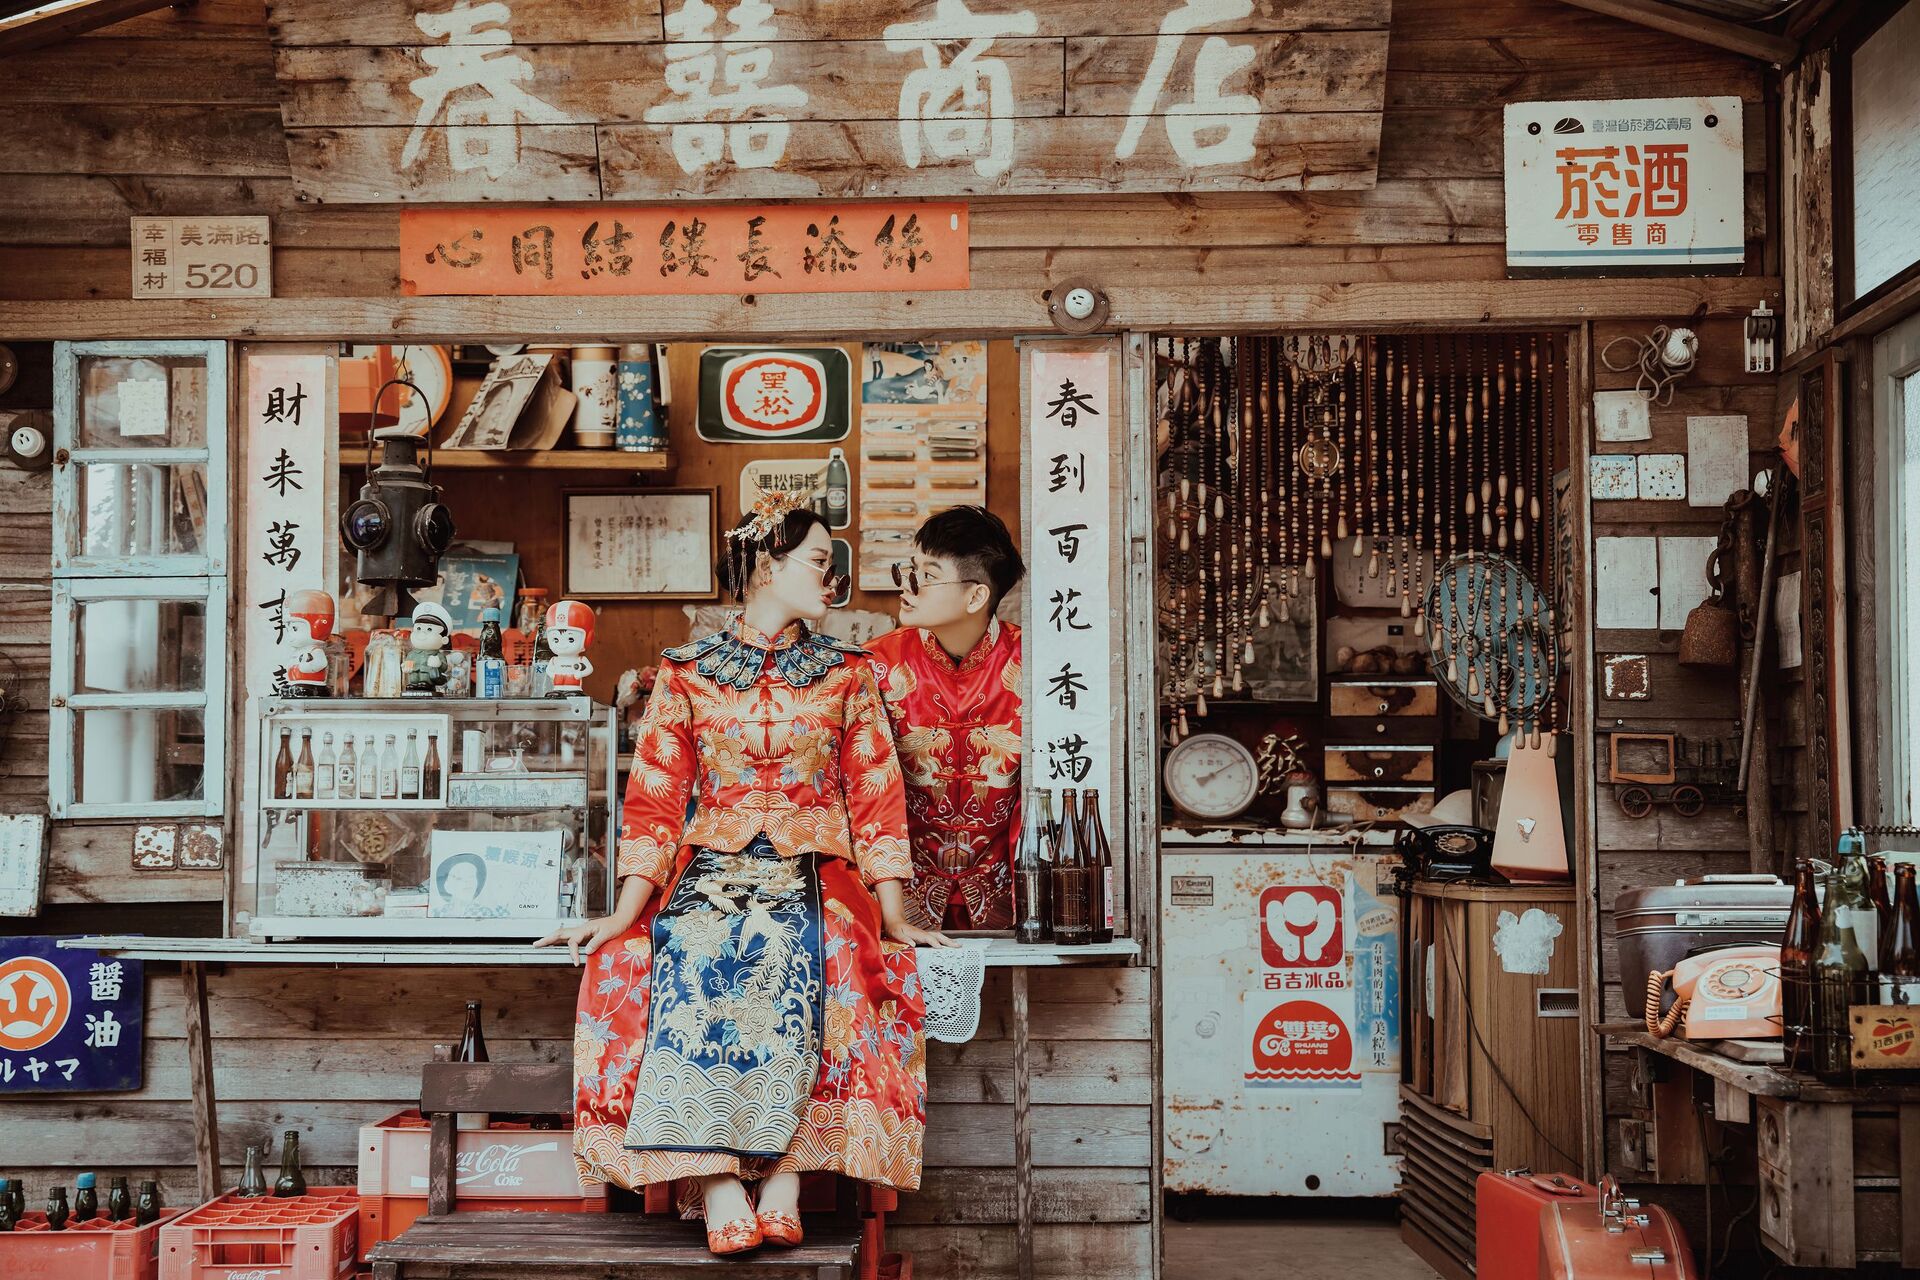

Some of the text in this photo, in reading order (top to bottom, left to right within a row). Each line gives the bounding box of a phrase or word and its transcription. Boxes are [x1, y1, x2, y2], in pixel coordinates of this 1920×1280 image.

[1554, 143, 1689, 219] 菸酒
[180, 224, 263, 247] 美滿路
[1577, 222, 1667, 246] 零售商
[142, 223, 168, 290] 幸福村
[185, 263, 258, 289] 520
[753, 371, 794, 417] 黑松
[1263, 971, 1345, 990] 百吉冰品
[84, 960, 124, 1048] 醬油
[1372, 1020, 1387, 1067] 美粒果
[494, 1173, 524, 1187] Coke
